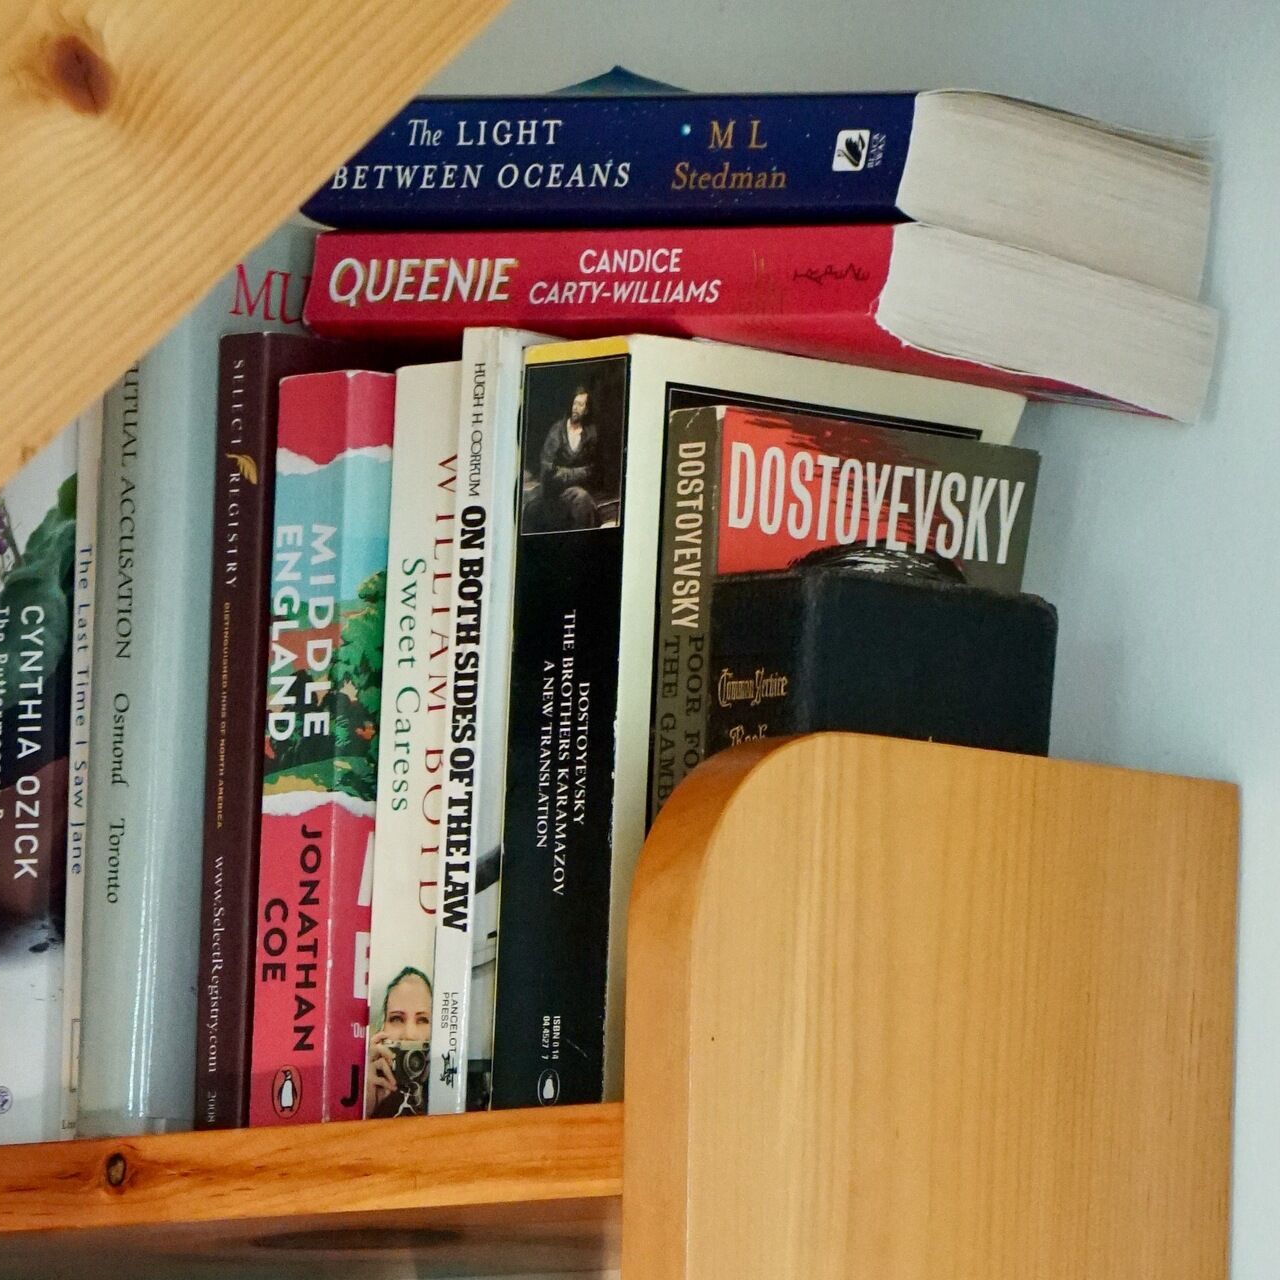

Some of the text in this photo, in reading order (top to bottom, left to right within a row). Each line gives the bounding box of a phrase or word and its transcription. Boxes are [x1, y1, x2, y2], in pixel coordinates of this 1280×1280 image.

[332, 160, 631, 191] BETWEEN OCEANS
[407, 118, 562, 148] The LIGHT
[671, 160, 787, 192] Stedman
[708, 119, 767, 149] M L
[328, 256, 519, 306] QUEENIE
[528, 278, 721, 306] CARTY-WILLIAMS
[579, 247, 682, 276] CANDICE
[671, 441, 706, 628] DOSTOYEVSKY
[728, 441, 1026, 565] DOSTOYEVSKY
[265, 525, 304, 742] ENGLAND
[302, 523, 338, 738] MIDDLE
[390, 557, 428, 812] Sweet Caress
[13, 604, 45, 879] CYNTHIA OZICK
[442, 505, 487, 932] ON BOTH SIDES OF THE LAW
[551, 608, 577, 896] THE BROTHERS KARAMAZOV
[571, 681, 590, 826] DOSTOYEVSKY
[206, 856, 226, 1073] www.SelectRegistry.com
[261, 897, 289, 983] COE
[292, 823, 323, 1052] JONATHAN
